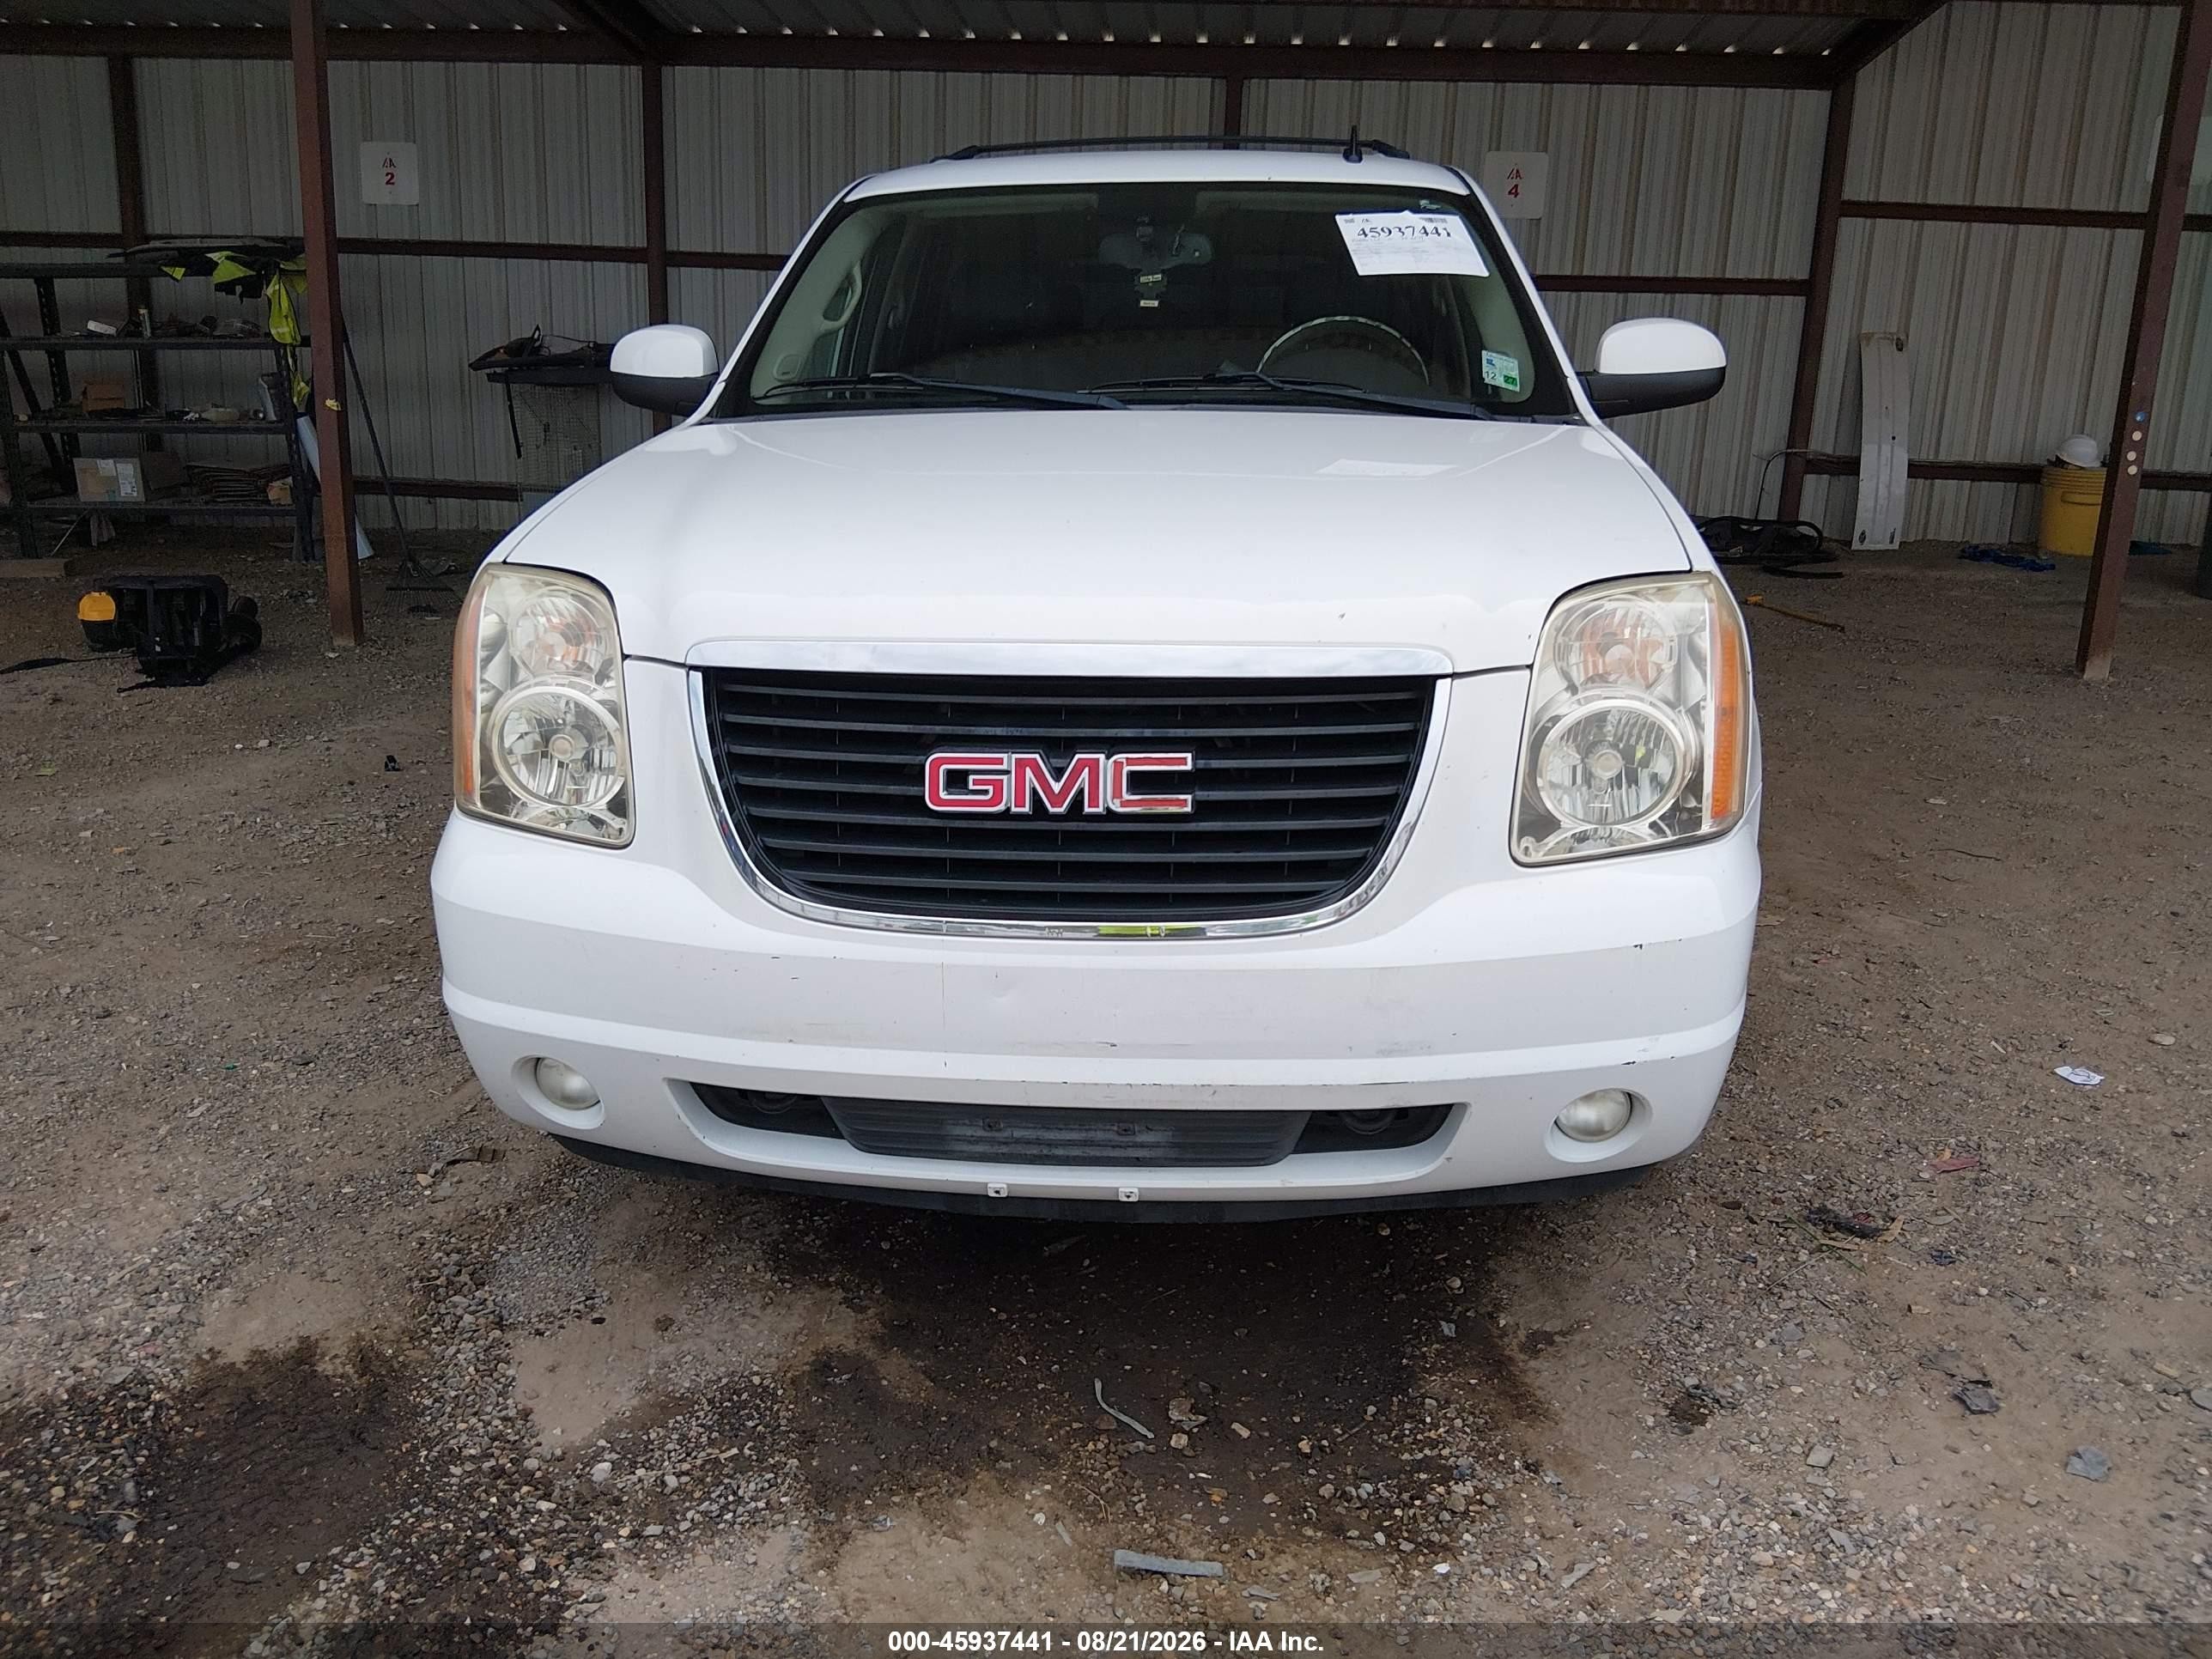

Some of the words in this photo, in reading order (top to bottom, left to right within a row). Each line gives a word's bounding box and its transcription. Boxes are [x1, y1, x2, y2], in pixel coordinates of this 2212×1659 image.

[385, 172, 395, 185] 2
[1507, 183, 1520, 198] 4
[1357, 225, 1452, 239] 45937441
[925, 751, 1194, 814] GMC
